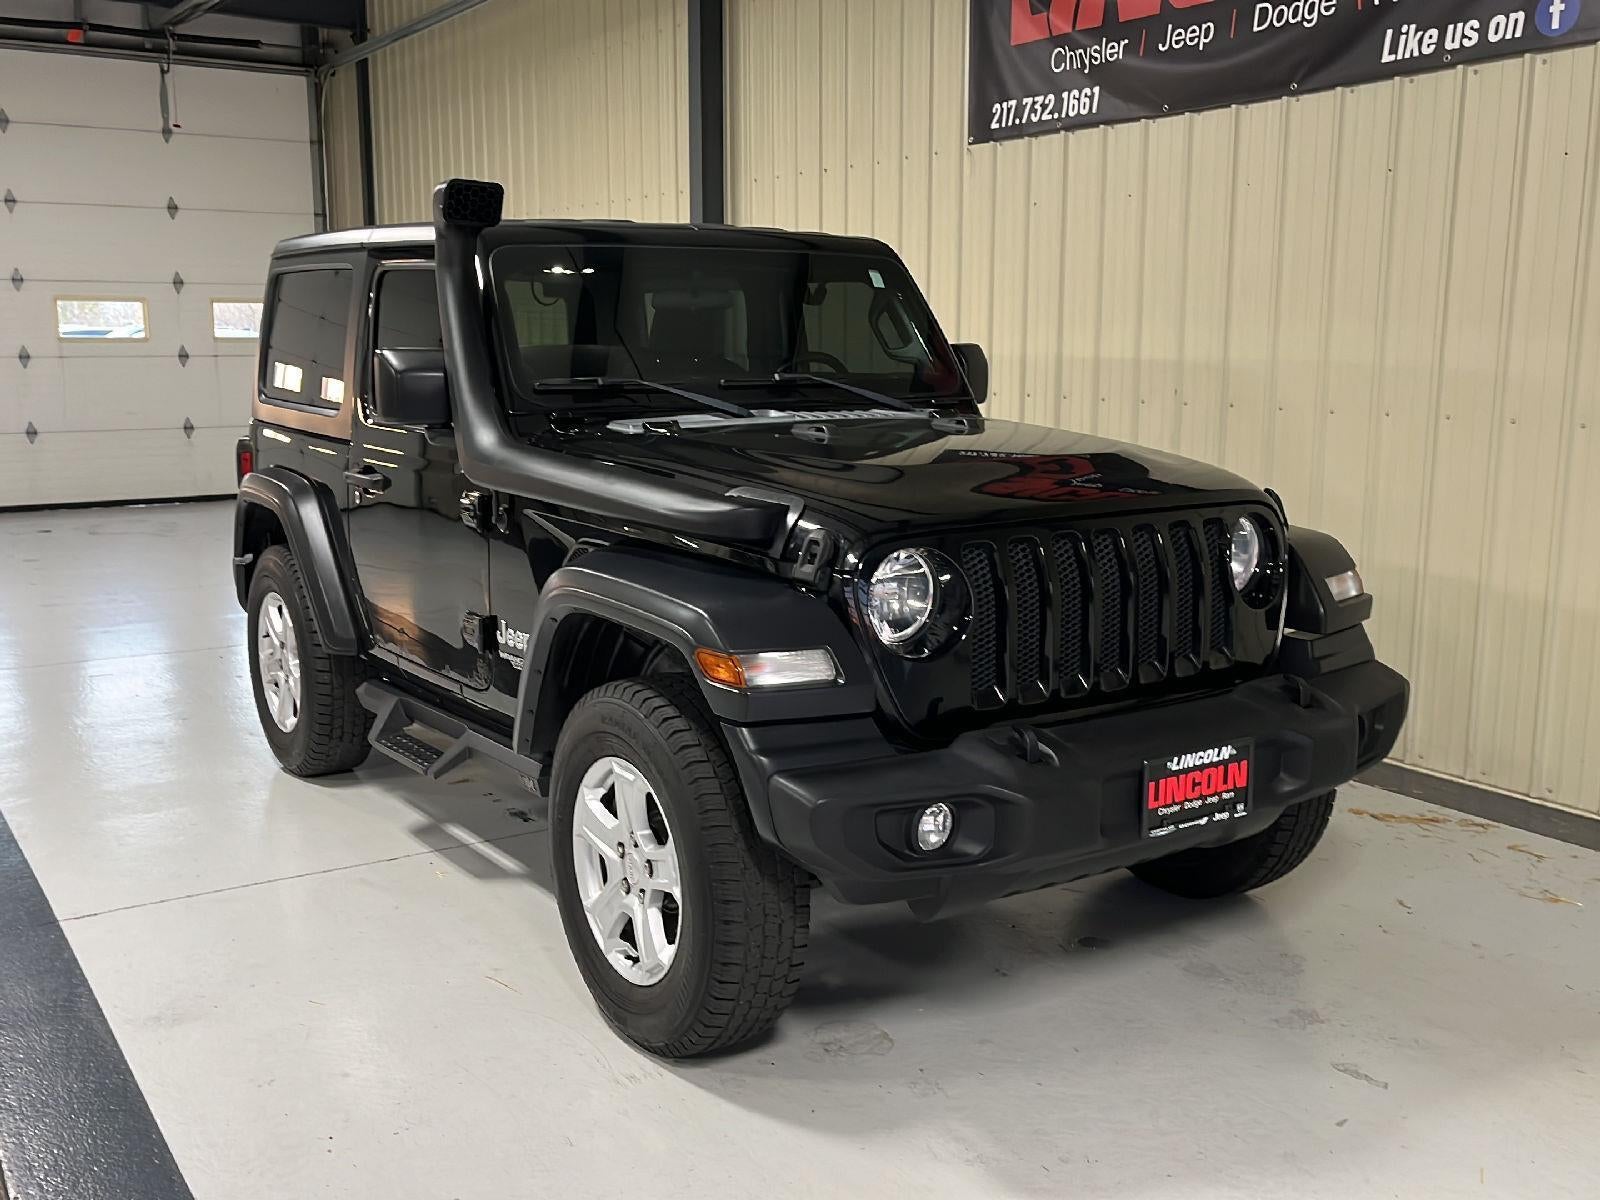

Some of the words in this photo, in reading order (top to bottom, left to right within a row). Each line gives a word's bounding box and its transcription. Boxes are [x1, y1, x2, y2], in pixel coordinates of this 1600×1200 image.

[1051, 38, 1128, 73] Chrysler
[1158, 21, 1215, 51] Jeep
[1252, 0, 1337, 32] Dodge
[1381, 23, 1437, 64] Like
[1444, 18, 1480, 51] us
[1487, 10, 1526, 43] on
[990, 86, 1100, 129] 217.732.1661
[1171, 745, 1232, 770] LINCOLN
[1148, 760, 1248, 809] LINCOLN
